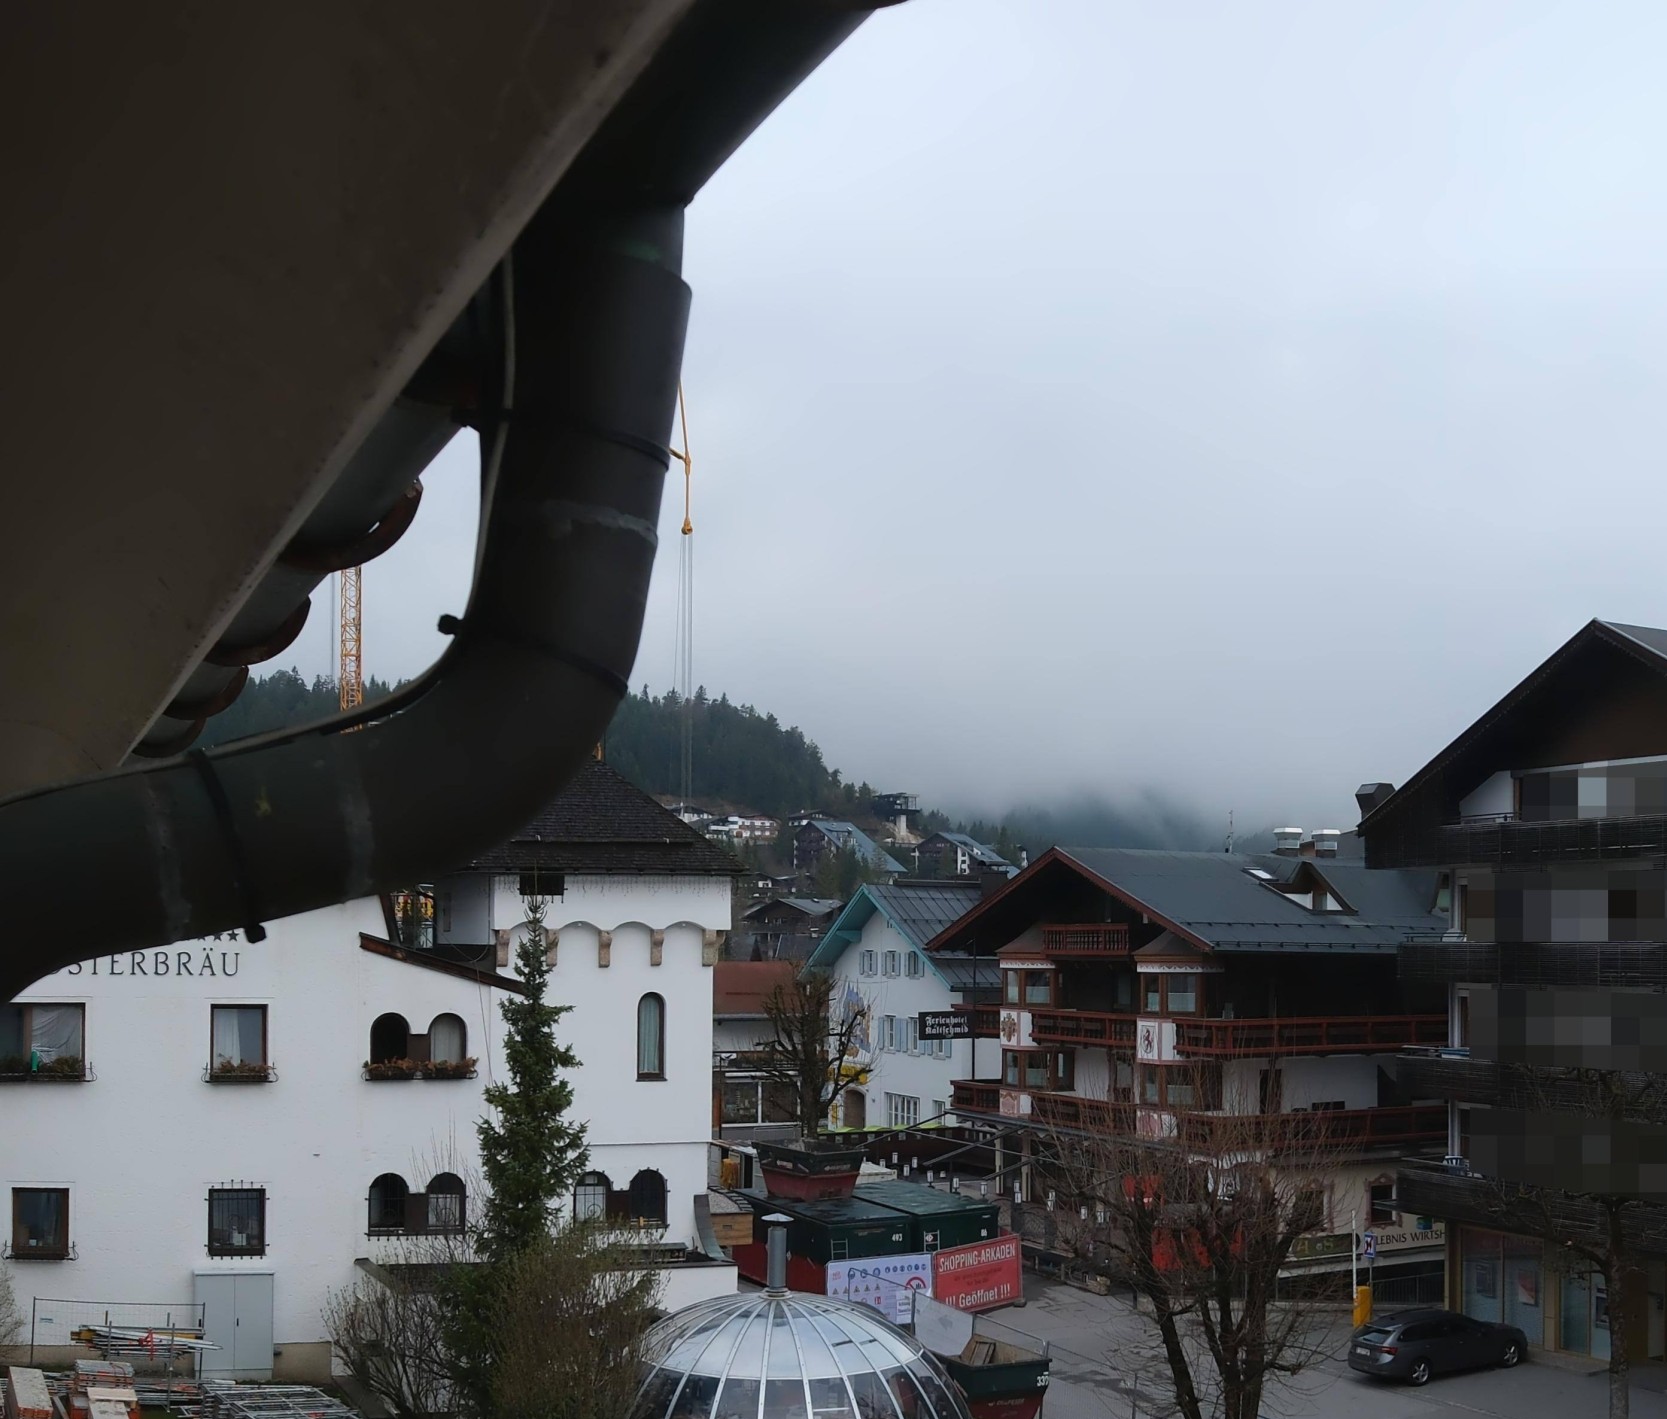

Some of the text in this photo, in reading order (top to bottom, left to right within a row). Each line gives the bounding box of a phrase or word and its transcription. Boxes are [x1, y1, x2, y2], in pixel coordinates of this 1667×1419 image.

[52, 947, 240, 977] STERBRÄU
[1376, 1232, 1407, 1246] LEBNIS
[938, 1243, 1016, 1274] SHOPPING-ARKADEN
[959, 1288, 998, 1308] Geöffnet
